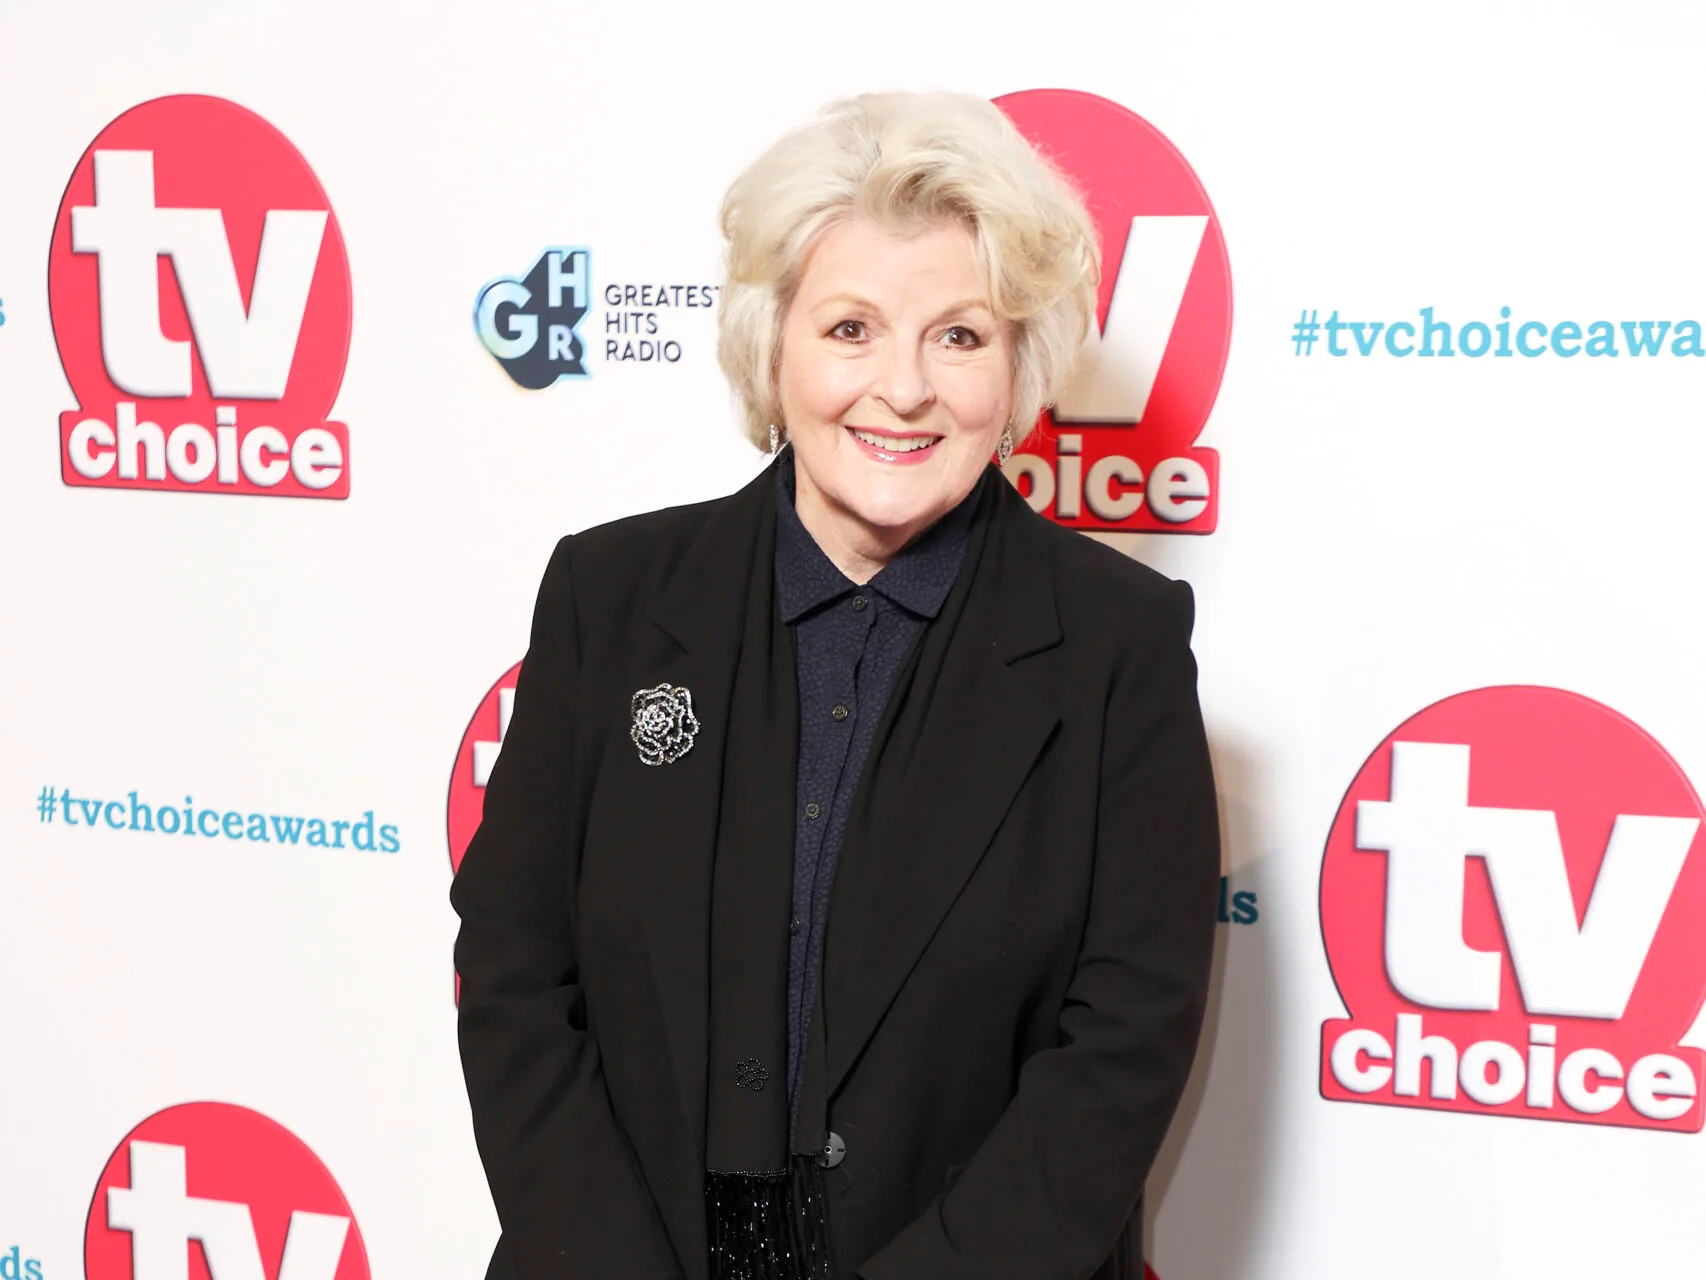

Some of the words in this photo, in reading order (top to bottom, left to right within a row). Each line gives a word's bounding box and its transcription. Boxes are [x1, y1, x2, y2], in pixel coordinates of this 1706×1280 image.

[71, 149, 329, 400] tv
[604, 284, 720, 308] GREATES
[605, 312, 658, 335] HITS
[605, 340, 683, 363] RADIO
[67, 402, 344, 490] choice
[37, 785, 401, 853] #tvchoiceawards
[1355, 741, 1701, 1020] tv
[1329, 1012, 1697, 1121] choice
